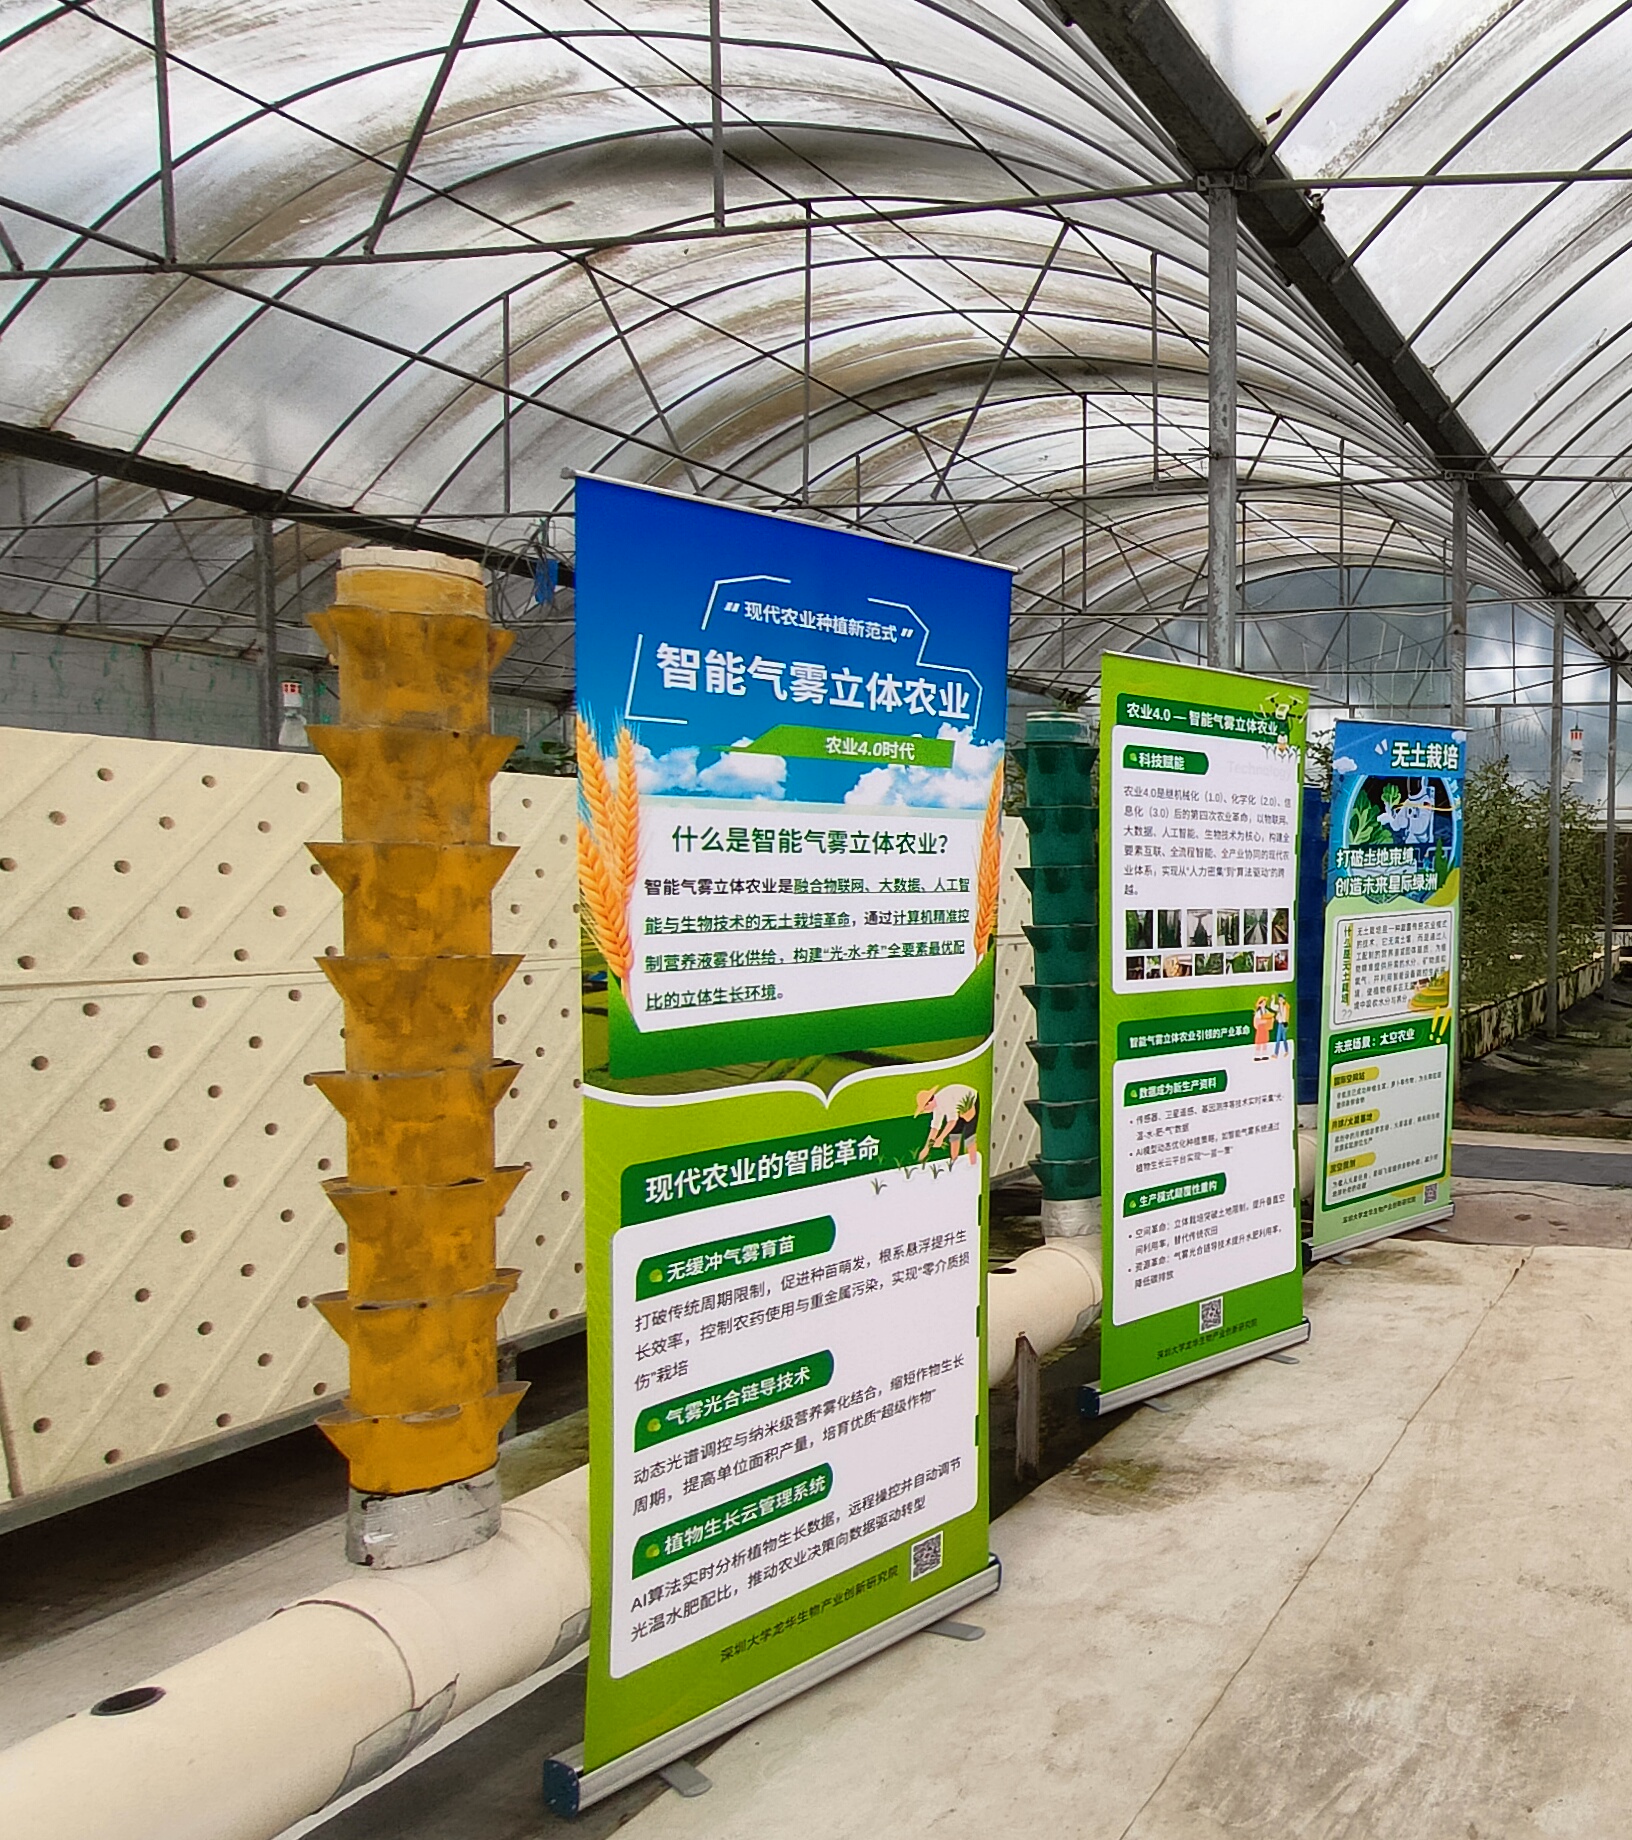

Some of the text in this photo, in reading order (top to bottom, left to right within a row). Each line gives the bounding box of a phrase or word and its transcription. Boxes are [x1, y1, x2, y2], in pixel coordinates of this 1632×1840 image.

[656, 643, 971, 719] 智能气雾立体农业
[825, 735, 915, 761] 农业4.0时代
[1139, 753, 1185, 770] 科技赋能
[1391, 741, 1459, 770] 无土栽培
[644, 878, 970, 895] 智能气雾立体农业是融合物联网、大数据、人工智
[1335, 873, 1438, 897] 创造未来星际绿洲
[644, 909, 969, 934] 能与生物技术的无土栽培革命，通过计算机精准控
[645, 984, 783, 1011] 比的立体生长环境。
[1129, 1025, 1250, 1048] 智能气雾立体农业引领的产业革命
[1139, 1077, 1217, 1099] 数据成为新生产资料
[645, 1135, 880, 1204] 现代农业的智能革命
[1139, 1181, 1217, 1208] 生产模式颠覆性重构
[667, 1235, 795, 1282] 无缓冲气雾育苗
[635, 1229, 967, 1332] 打破传统周期限制，促进种苗萌发，根系悬浮提升生
[665, 1366, 810, 1426] 气雾光合链导技术
[633, 1353, 965, 1485] 动态光谱调控与纳米级营养雾化结合，缩短作物生长
[630, 1456, 961, 1612] AI算法实时分析植物生长数据，远程操控并自动调节
[664, 1474, 826, 1556] 植物生长云管理系统
[630, 1495, 926, 1642] 光温水肥配比，推动农业决策向数据驱动转型
[719, 1565, 898, 1662] 深圳大学龙华生物产业创新研究院
